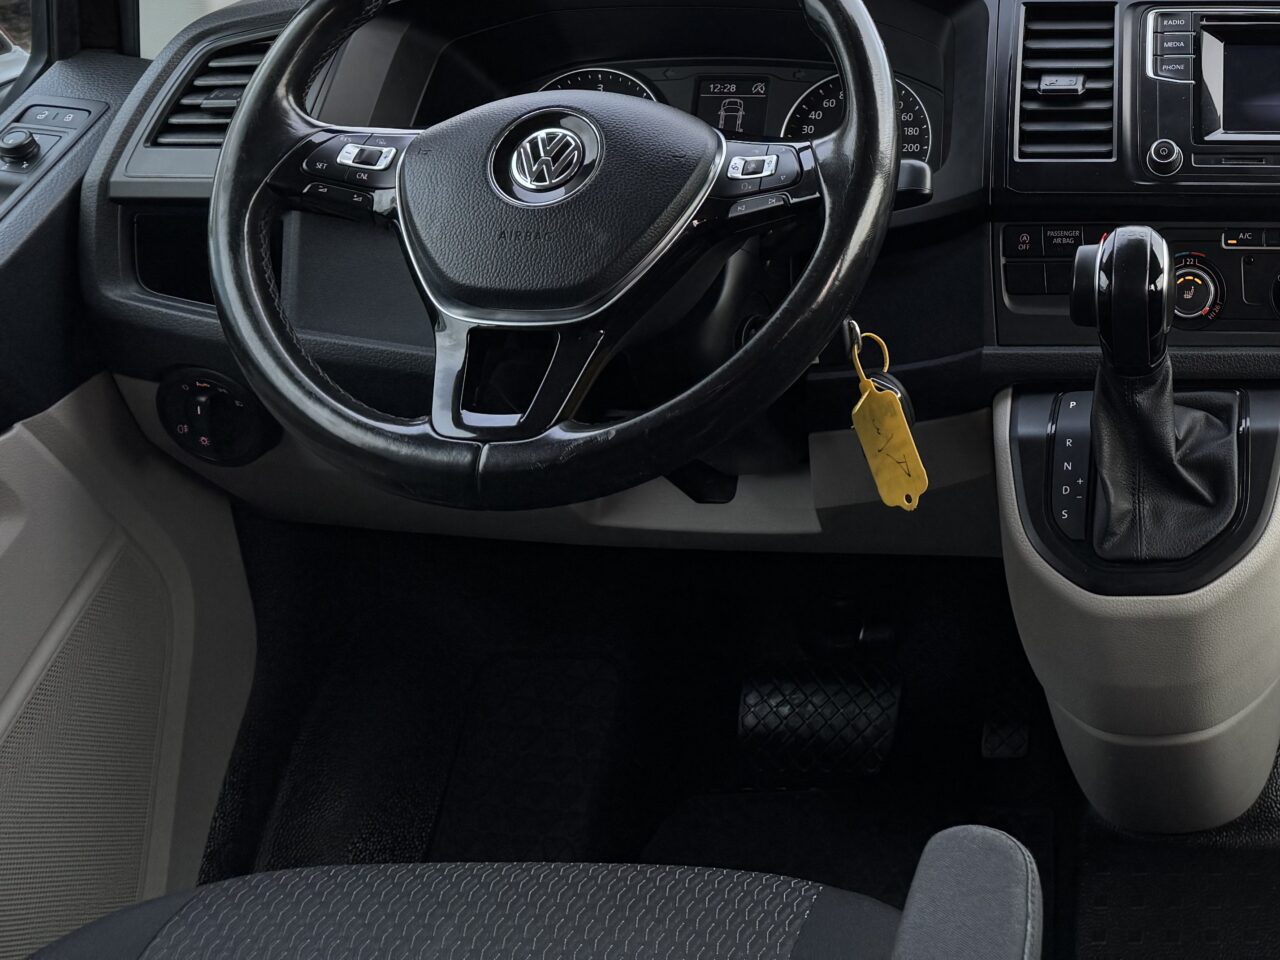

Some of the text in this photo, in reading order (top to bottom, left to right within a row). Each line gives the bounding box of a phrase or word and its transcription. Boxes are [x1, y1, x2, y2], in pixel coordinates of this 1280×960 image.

[709, 84, 737, 92] 12:28
[822, 99, 836, 108] 60
[808, 111, 823, 120] 40
[901, 112, 914, 121] 60
[801, 125, 815, 134] 30
[903, 127, 920, 135] 180
[902, 143, 920, 152] 200
[315, 162, 329, 170] SET
[1239, 232, 1253, 240] A/C
[1066, 439, 1073, 447] R
[1063, 462, 1072, 470] N
[1062, 485, 1070, 495] D
[1061, 510, 1068, 519] S
